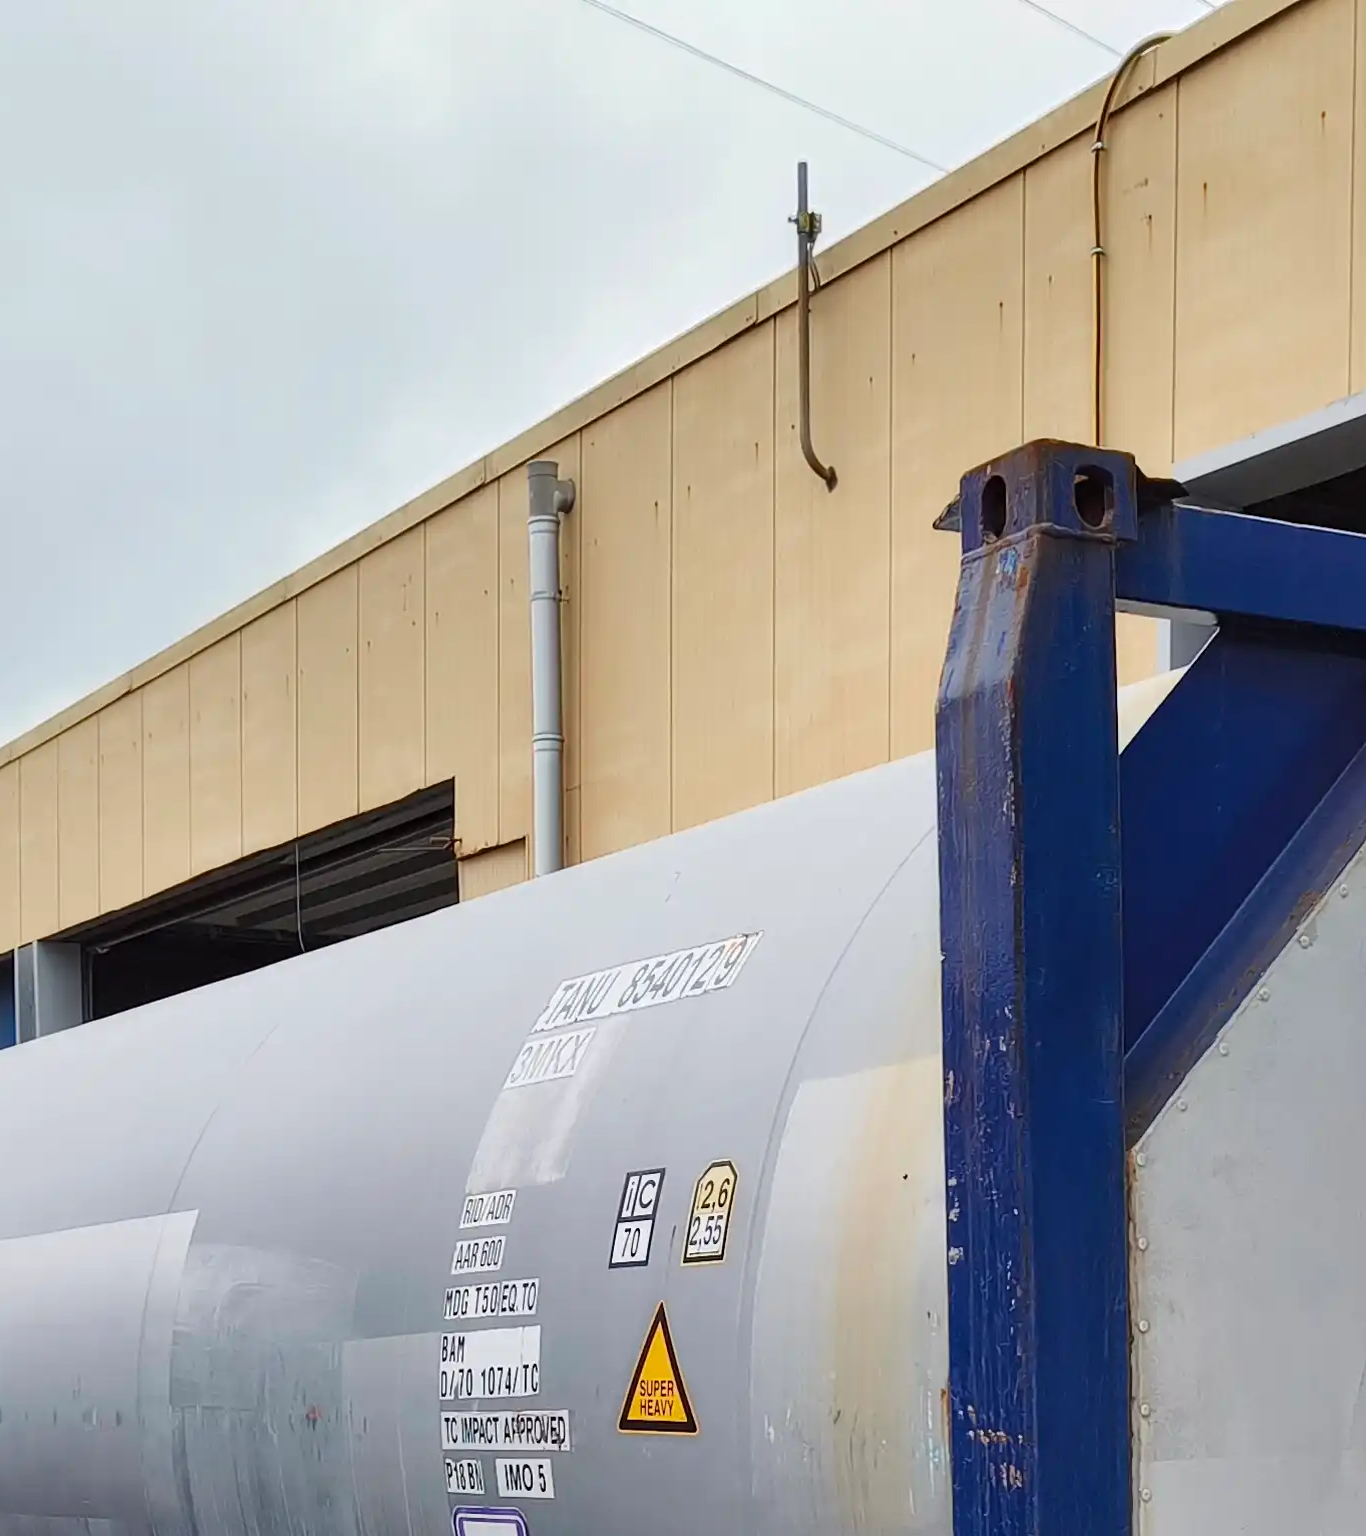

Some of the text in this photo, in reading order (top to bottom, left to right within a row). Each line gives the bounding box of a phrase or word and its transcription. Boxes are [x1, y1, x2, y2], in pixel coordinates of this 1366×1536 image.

[545, 969, 621, 1025] TANU
[510, 1031, 591, 1084] 3MKX
[462, 1193, 513, 1224] RID/ADR
[622, 1227, 641, 1257] 70
[689, 1215, 724, 1250] 2,55
[455, 1239, 502, 1269] AAR 600
[442, 1335, 465, 1363] BAM
[640, 1380, 674, 1397] SUPER
[640, 1399, 674, 1416] HEAVY
[444, 1414, 566, 1444] TC IMPACT APPROVED
[504, 1464, 546, 1492] IMO 5
